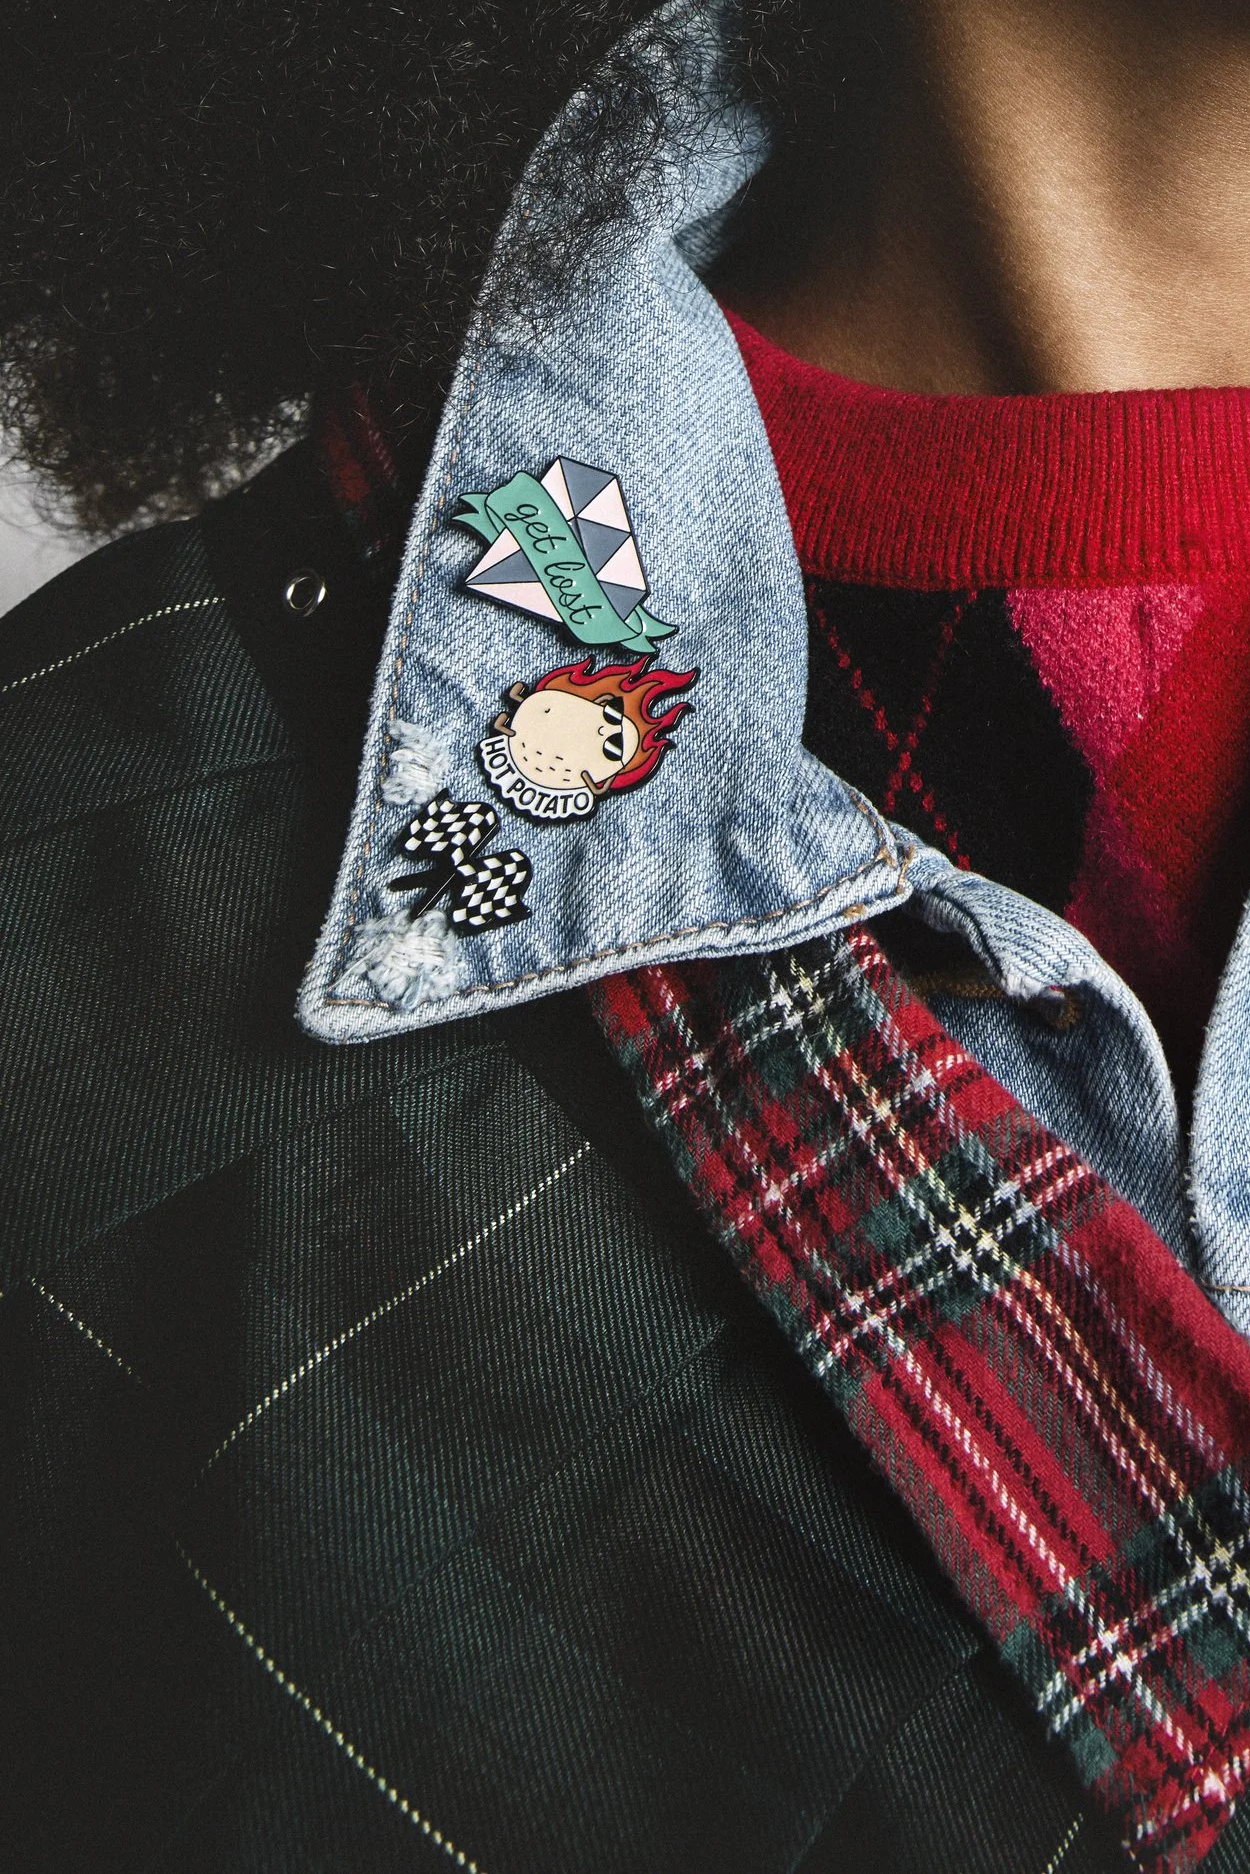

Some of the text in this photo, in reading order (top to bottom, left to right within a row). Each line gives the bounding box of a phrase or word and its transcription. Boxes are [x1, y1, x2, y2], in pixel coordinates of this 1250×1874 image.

[503, 503, 603, 625] get lost
[484, 737, 590, 815] HOT POTATO
